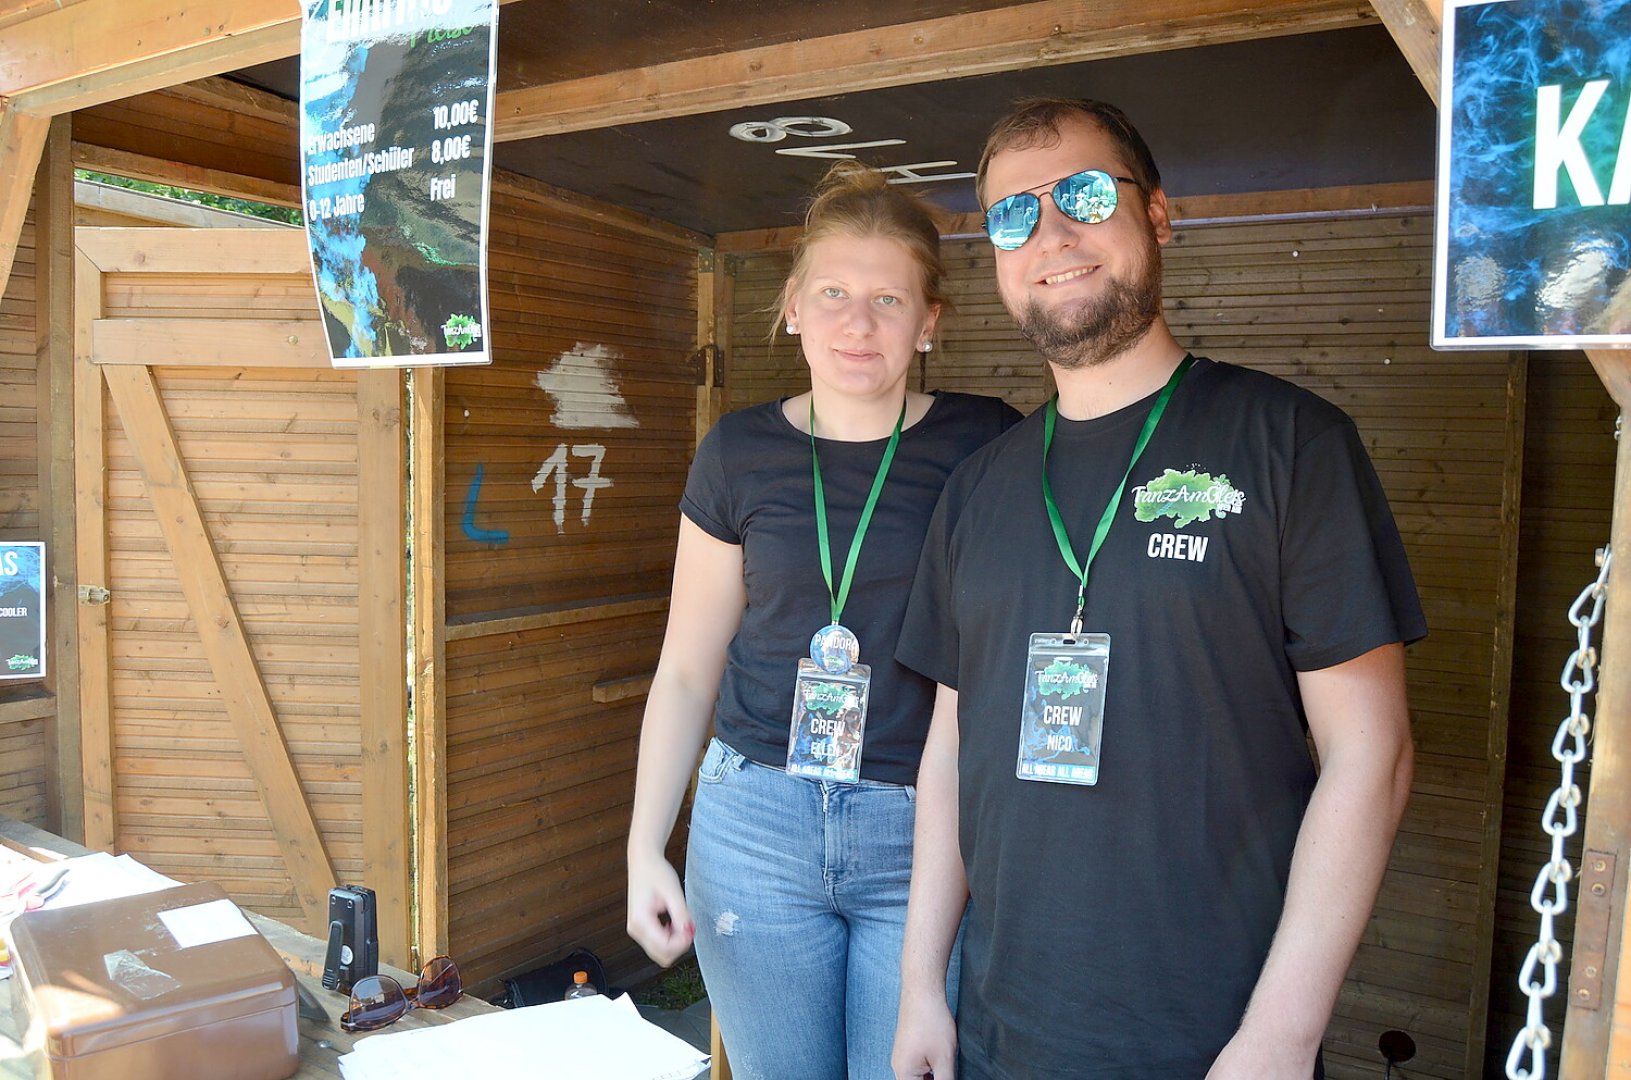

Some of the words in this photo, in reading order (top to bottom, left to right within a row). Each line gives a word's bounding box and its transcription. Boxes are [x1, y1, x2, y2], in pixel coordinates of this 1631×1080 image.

[432, 99, 480, 130] 10,00€
[307, 147, 415, 187] Studenten/Schüler
[431, 135, 472, 165] 8,00€
[308, 197, 332, 221] 0-12
[333, 193, 365, 218] Jahre
[430, 174, 457, 201] Frei
[531, 443, 614, 535] 17
[1146, 532, 1209, 562] CREW
[0, 550, 18, 577] S
[810, 718, 845, 737] CREW
[1043, 705, 1083, 727] CREW
[1046, 734, 1073, 752] NICO
